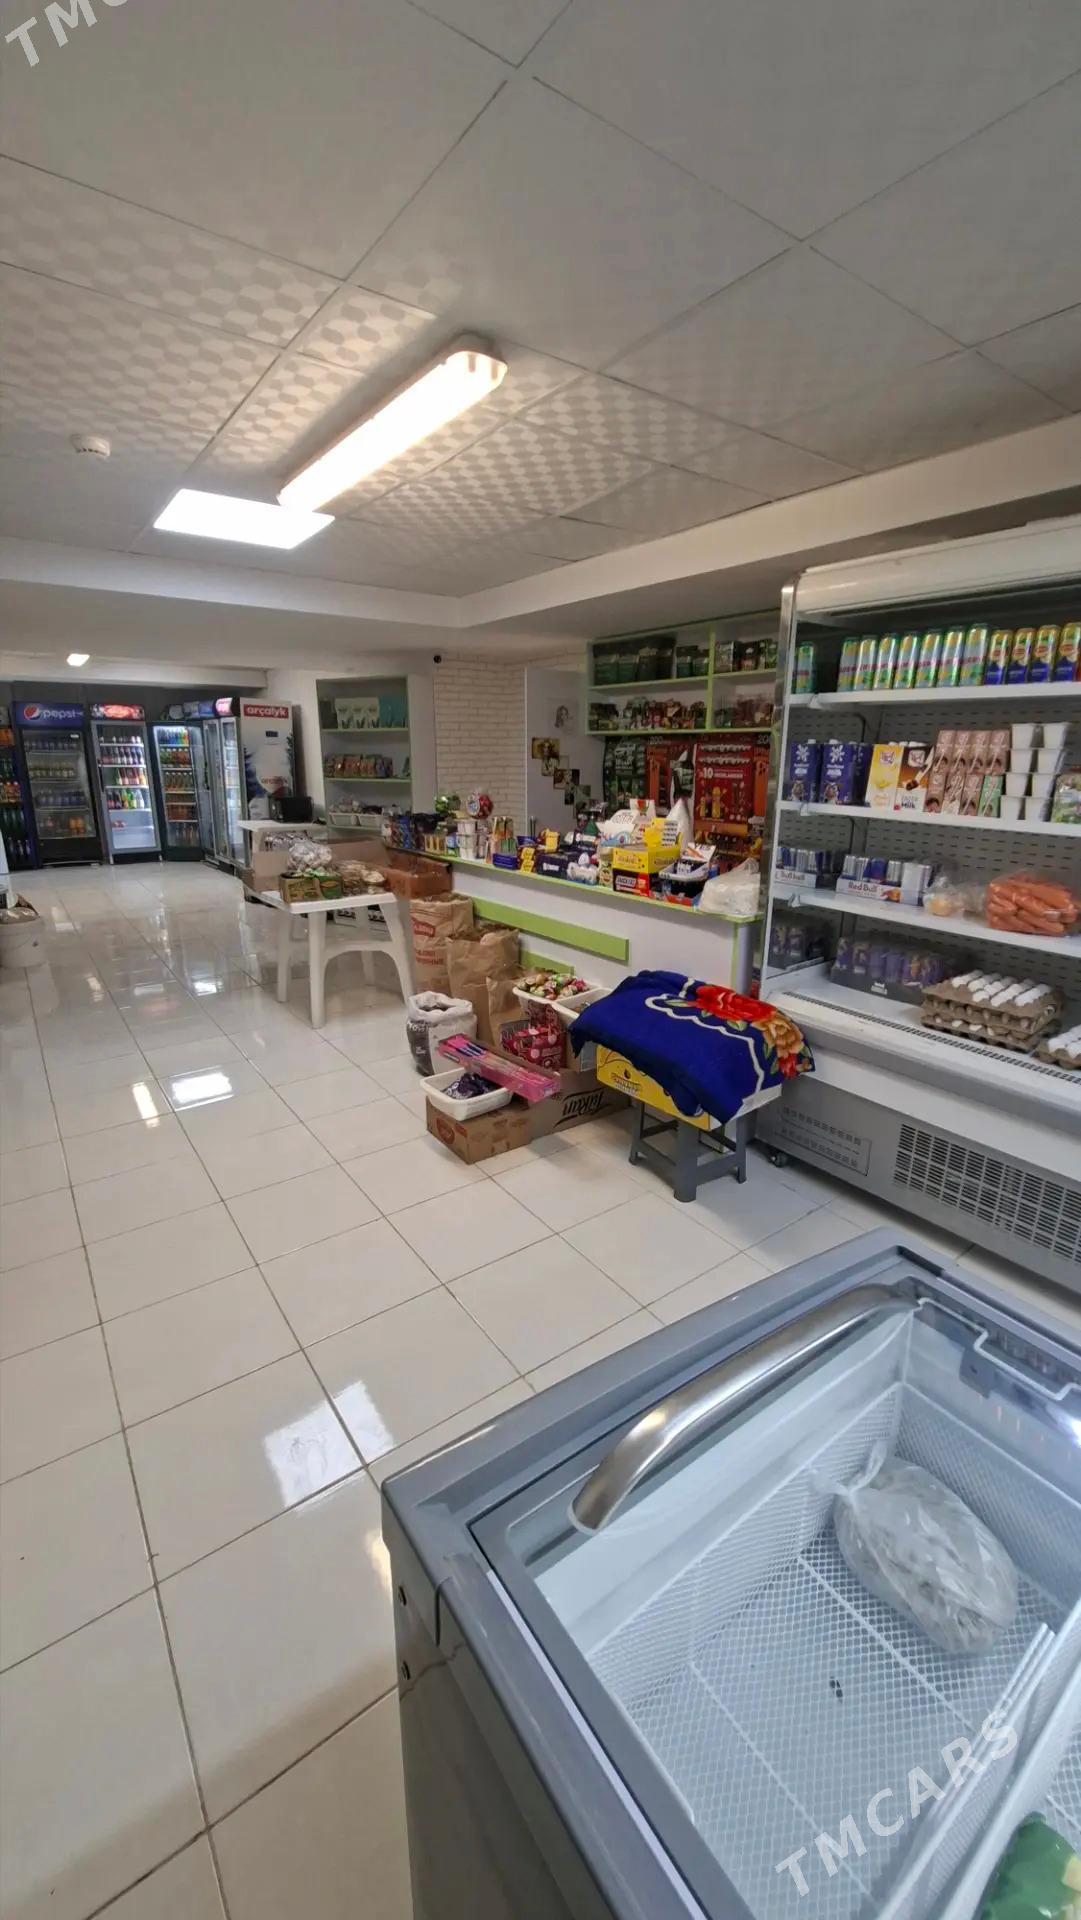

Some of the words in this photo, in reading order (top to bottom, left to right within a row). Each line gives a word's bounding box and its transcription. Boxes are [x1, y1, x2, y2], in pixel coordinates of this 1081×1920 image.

[43, 709, 76, 720] pepsi
[247, 705, 287, 718] arçalyk
[848, 881, 863, 890] Red
[863, 883, 878, 893] Bull
